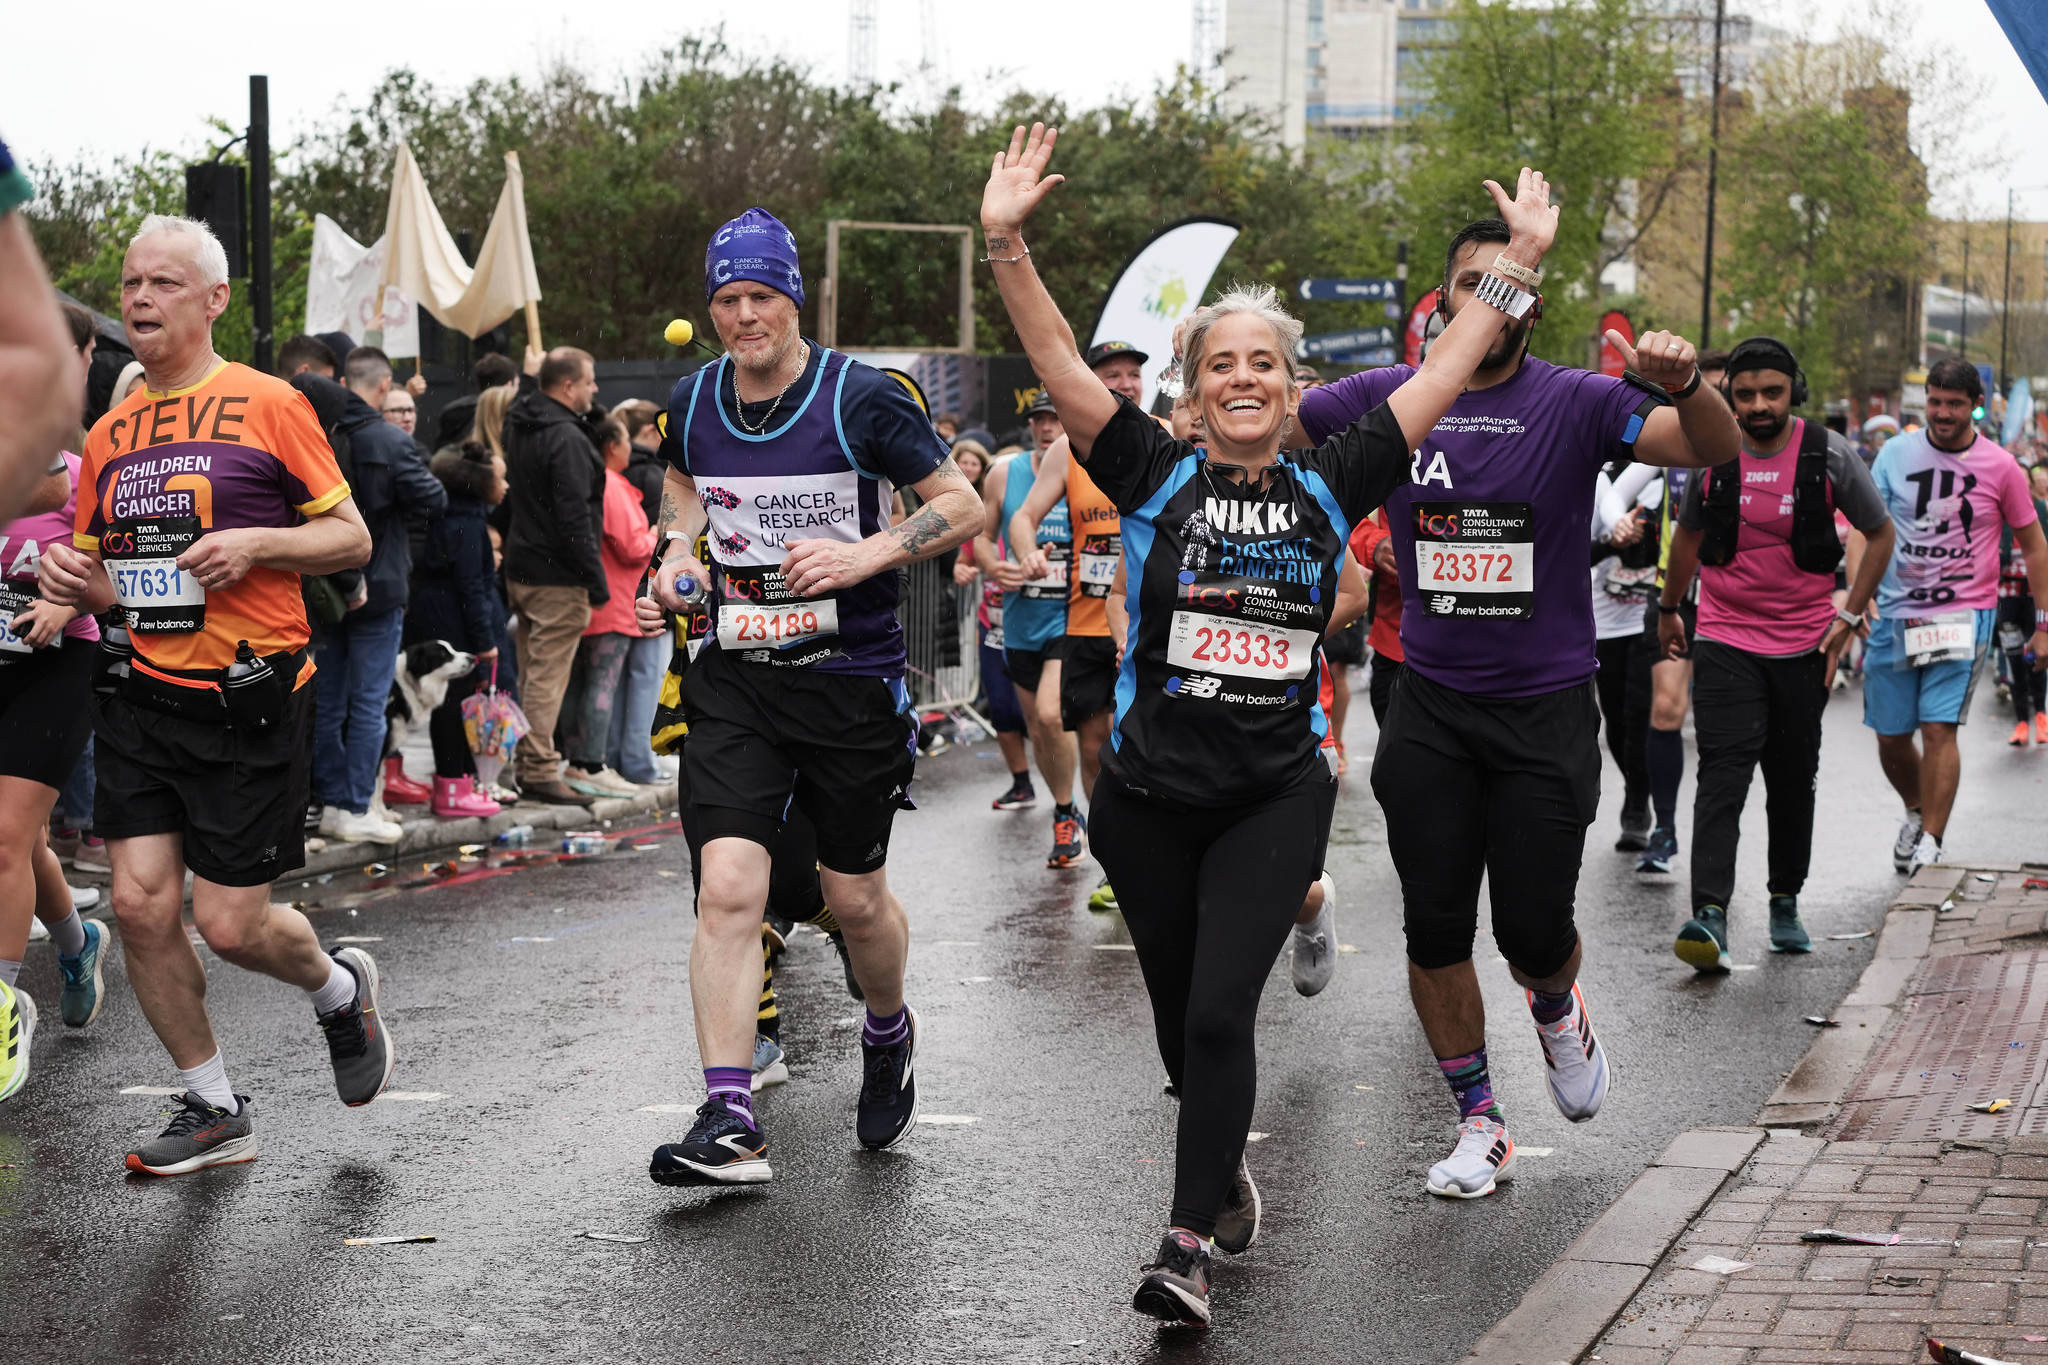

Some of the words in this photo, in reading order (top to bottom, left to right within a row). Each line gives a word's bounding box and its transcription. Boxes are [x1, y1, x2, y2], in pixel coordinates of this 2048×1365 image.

[106, 396, 249, 460] STEVE
[1437, 416, 1469, 425] ONDON
[1470, 416, 1518, 425] MARATHON
[1458, 424, 1479, 433] 23RD
[1480, 424, 1505, 433] APRIL
[1506, 425, 1525, 433] 2023
[120, 456, 211, 481] CHILDREN
[1744, 471, 1779, 483] ZIGGY
[117, 477, 160, 499] WITH
[115, 493, 191, 518] CANCER
[754, 491, 836, 510] CANCER
[758, 504, 855, 529] RESEARCH
[1462, 509, 1489, 517] TATA
[137, 525, 160, 534] TATA
[1419, 509, 1458, 536] tcs
[1462, 519, 1525, 527] CONSULTANCY
[137, 533, 194, 543] CONSULTANCY
[1036, 525, 1067, 537] PHIL
[1462, 528, 1502, 537] SERVICES
[760, 532, 786, 548] UK
[137, 543, 172, 553] SERVICES
[1432, 552, 1512, 582] 23372
[117, 568, 181, 597] 57631
[725, 573, 761, 599] tcs
[765, 590, 803, 600] SERVIC
[1188, 583, 1239, 610] tcs
[1246, 585, 1278, 597] TATA
[1908, 587, 1956, 602] GO
[1244, 596, 1314, 614] CONSULTANCY
[1456, 607, 1477, 615] new
[1478, 606, 1522, 616] balance
[1241, 606, 1288, 620] SERVICES
[140, 620, 156, 630] new
[156, 619, 195, 629] balance
[691, 612, 713, 635] tc
[735, 611, 818, 641] 23189
[1192, 627, 1290, 669] 23333
[791, 648, 831, 667] balance
[1220, 692, 1245, 703] new
[1246, 693, 1287, 705] balance
